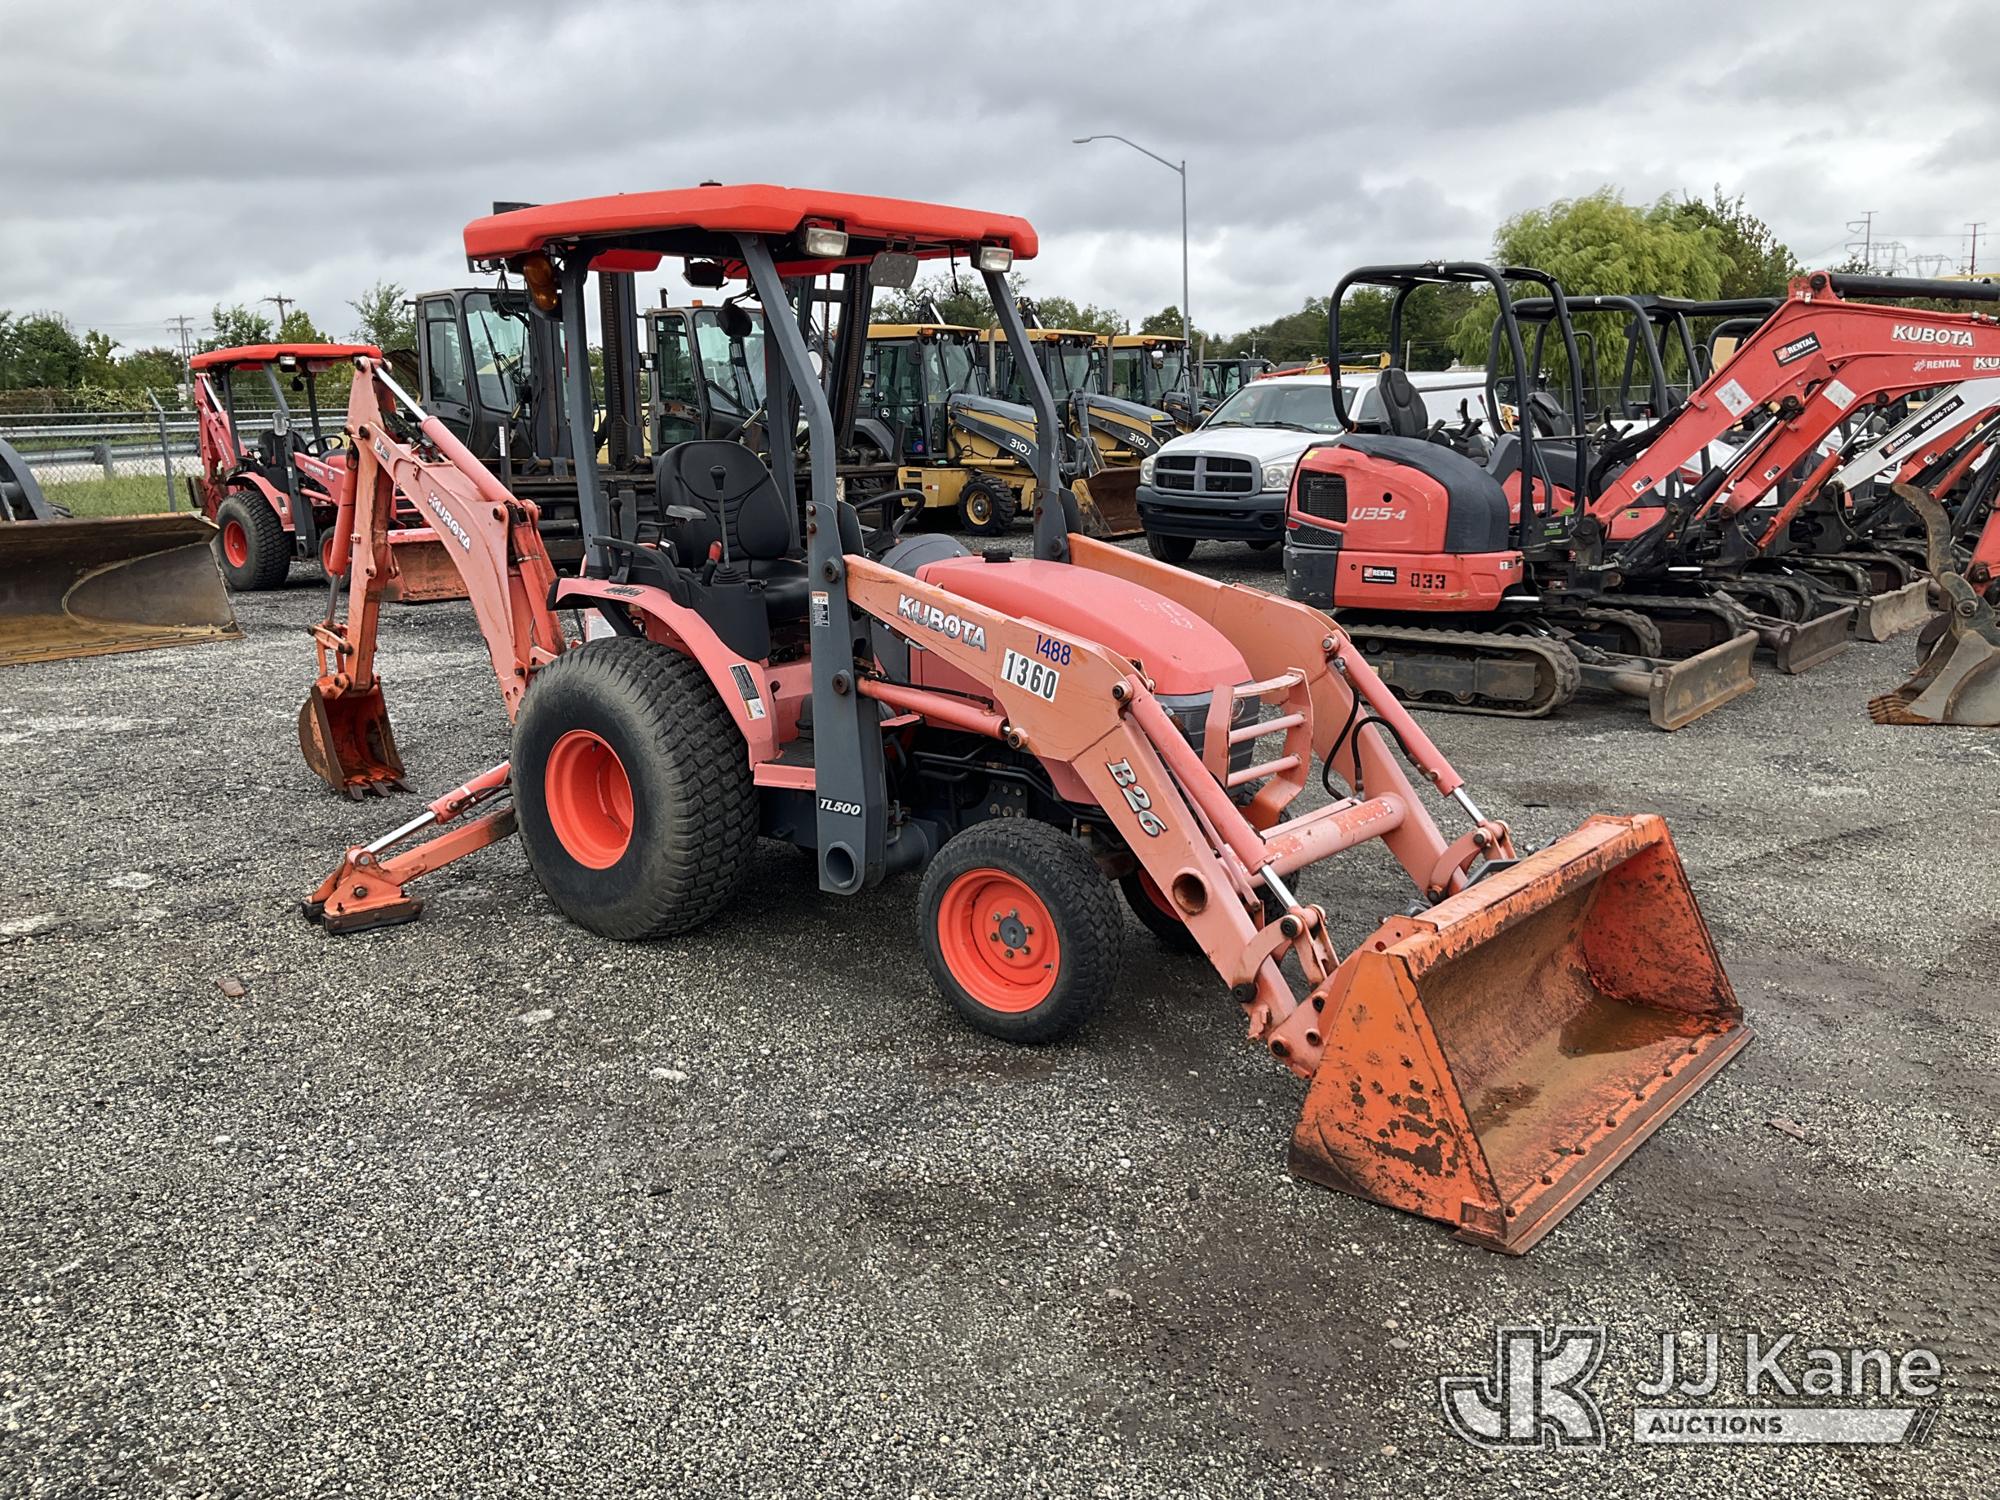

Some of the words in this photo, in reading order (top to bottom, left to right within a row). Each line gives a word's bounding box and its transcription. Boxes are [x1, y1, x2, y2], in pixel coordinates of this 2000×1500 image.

[1892, 325, 1974, 346] KUBOTA
[1787, 336, 1816, 354] RENTAL
[1926, 359, 1961, 369] RENTAL
[1009, 438, 1032, 456] 310J
[1128, 432, 1150, 449] 310J
[1351, 507, 1407, 520] U35-4
[1372, 569, 1395, 578] RENTAL
[1411, 573, 1446, 589] 033
[898, 594, 987, 651] KUBOTA
[1035, 634, 1072, 666] 1488
[1005, 652, 1060, 699] 1360
[820, 798, 861, 815] TL500
[1106, 758, 1168, 837] B26
